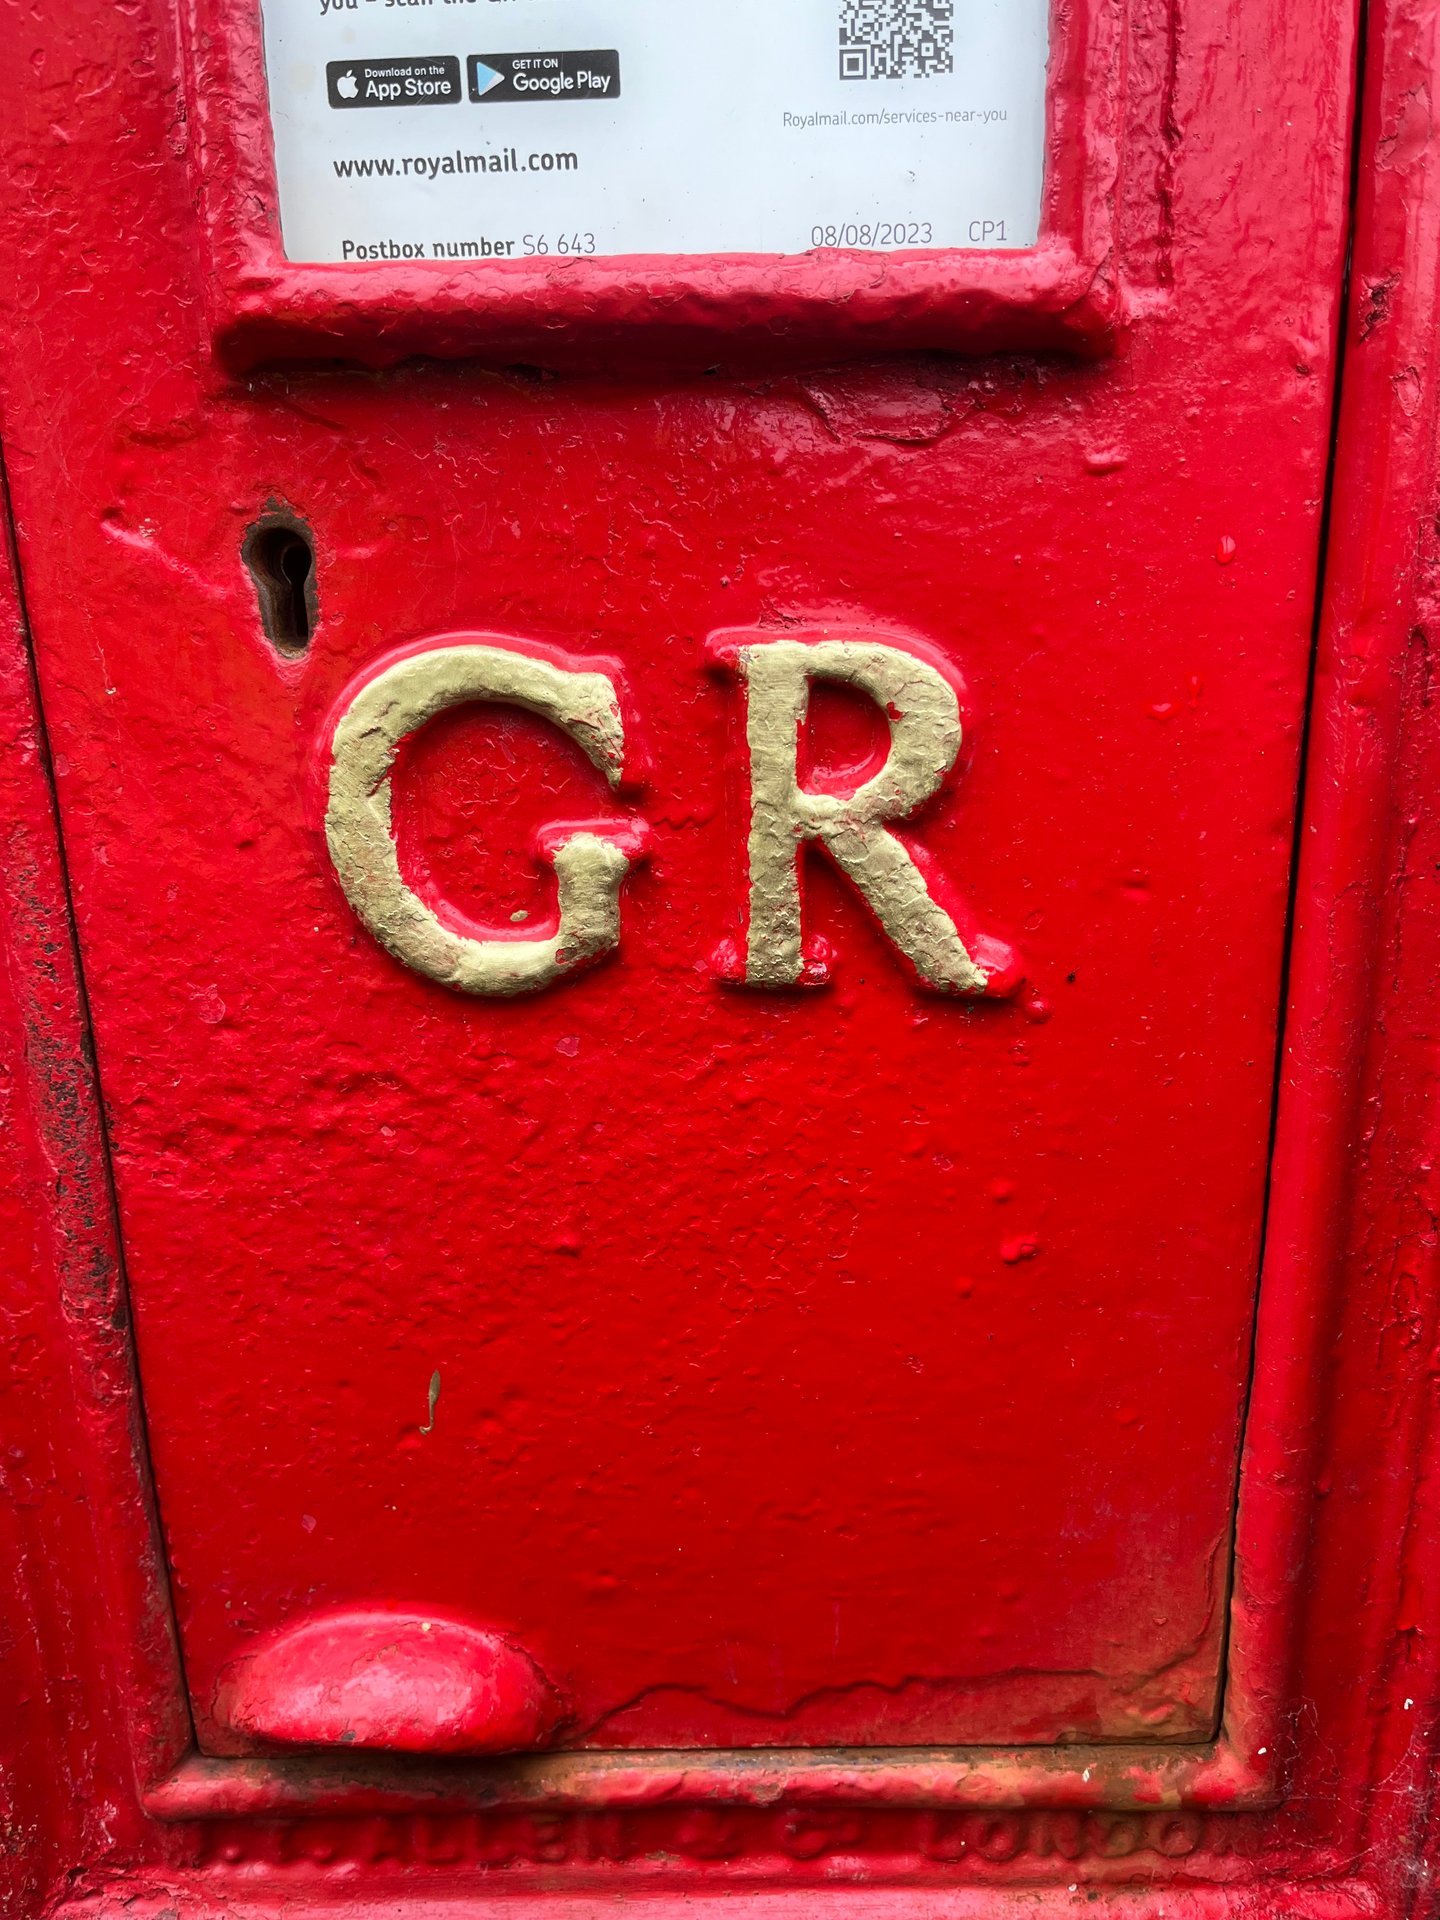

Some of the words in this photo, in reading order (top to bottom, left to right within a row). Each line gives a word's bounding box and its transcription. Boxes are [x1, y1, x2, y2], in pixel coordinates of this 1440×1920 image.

[320, 0, 358, 16] you
[365, 66, 411, 77] Download
[415, 67, 429, 75] on
[429, 65, 445, 75] the
[512, 60, 531, 69] GET
[533, 59, 541, 68] IT
[544, 59, 558, 68] ON
[366, 81, 401, 101] App
[405, 78, 451, 96] Store
[513, 71, 574, 93] Google
[577, 71, 611, 92] Play
[783, 109, 1008, 129] Royalmail.com/services-near-you
[333, 148, 578, 179] www.royalmail.com
[811, 222, 933, 247] 08/08/2023
[968, 220, 1008, 242] CP1
[342, 240, 425, 260] Postbox
[432, 237, 515, 257] number
[522, 234, 549, 256] S6
[557, 233, 596, 255] 643
[922, 1808, 1270, 1862] LONDON
